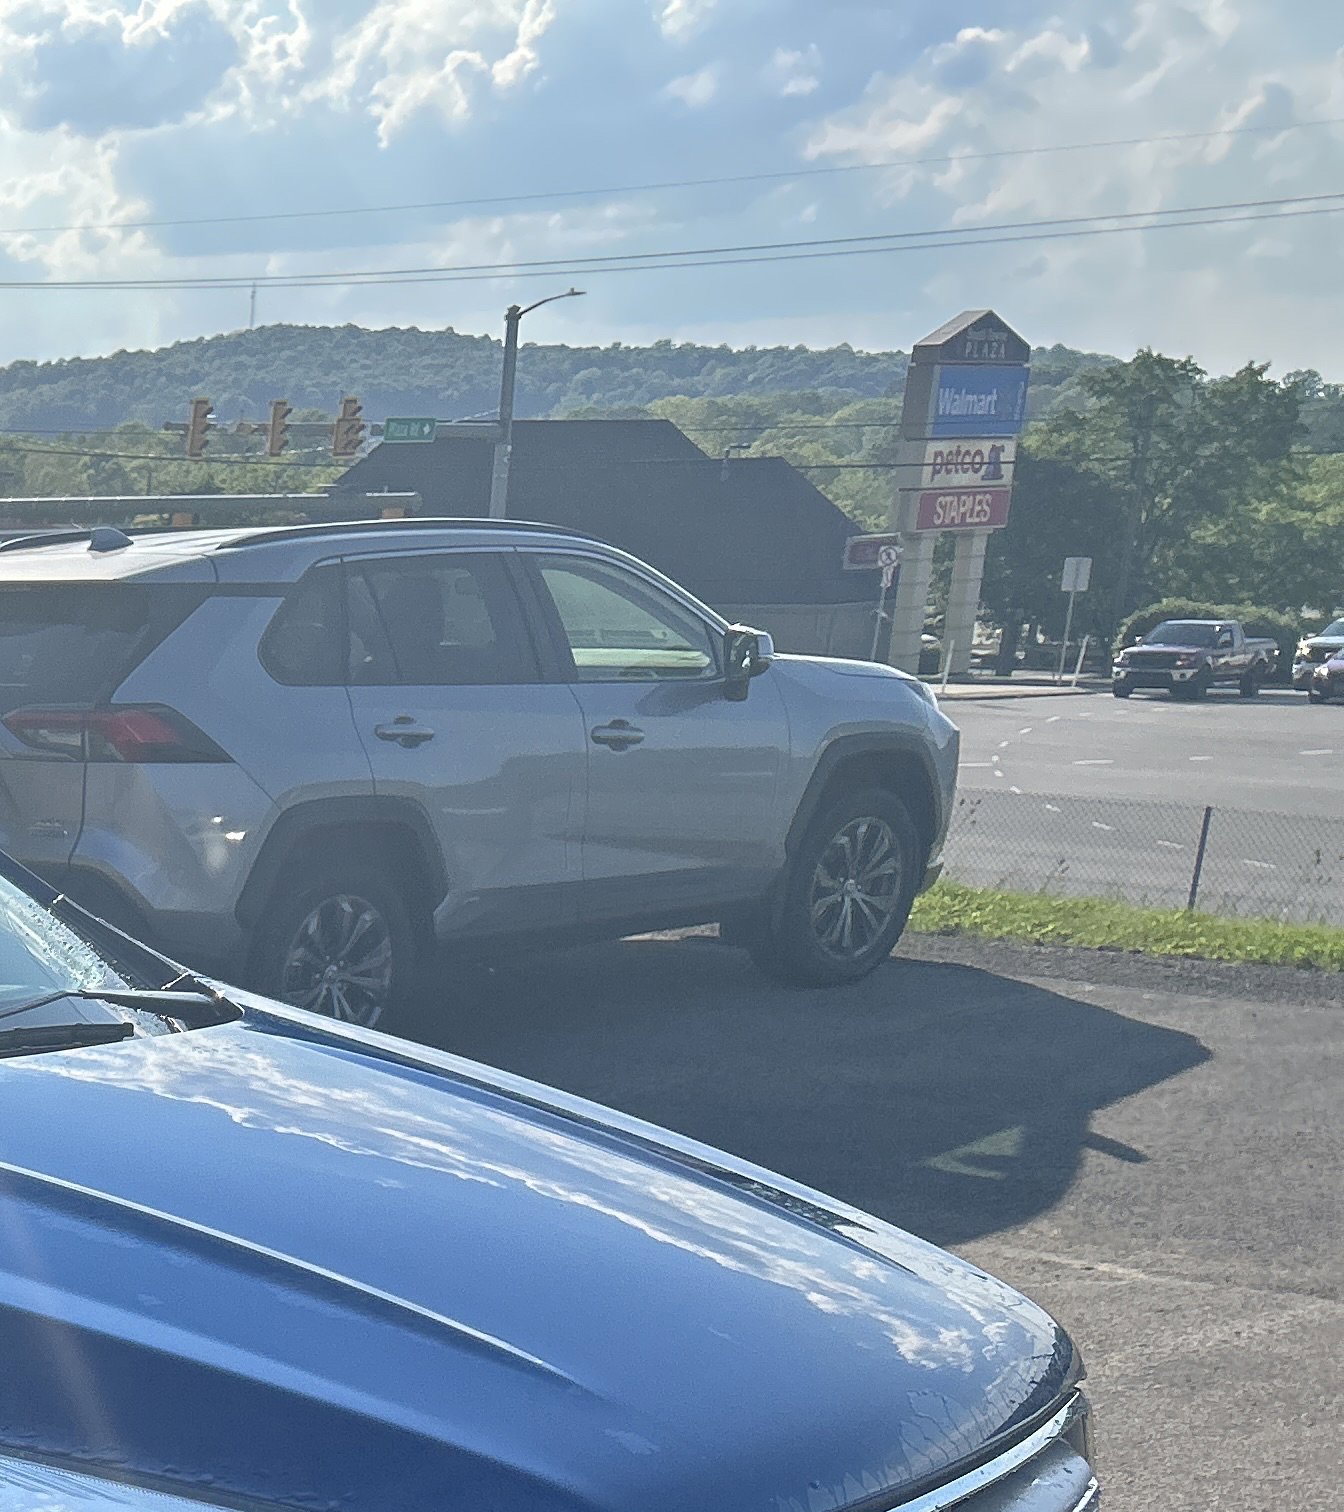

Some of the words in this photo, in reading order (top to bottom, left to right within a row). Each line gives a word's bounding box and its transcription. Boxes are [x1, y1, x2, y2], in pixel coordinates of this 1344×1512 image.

[937, 387, 998, 416] Walmart
[930, 445, 985, 482] petco
[933, 493, 993, 525] STAPLES
